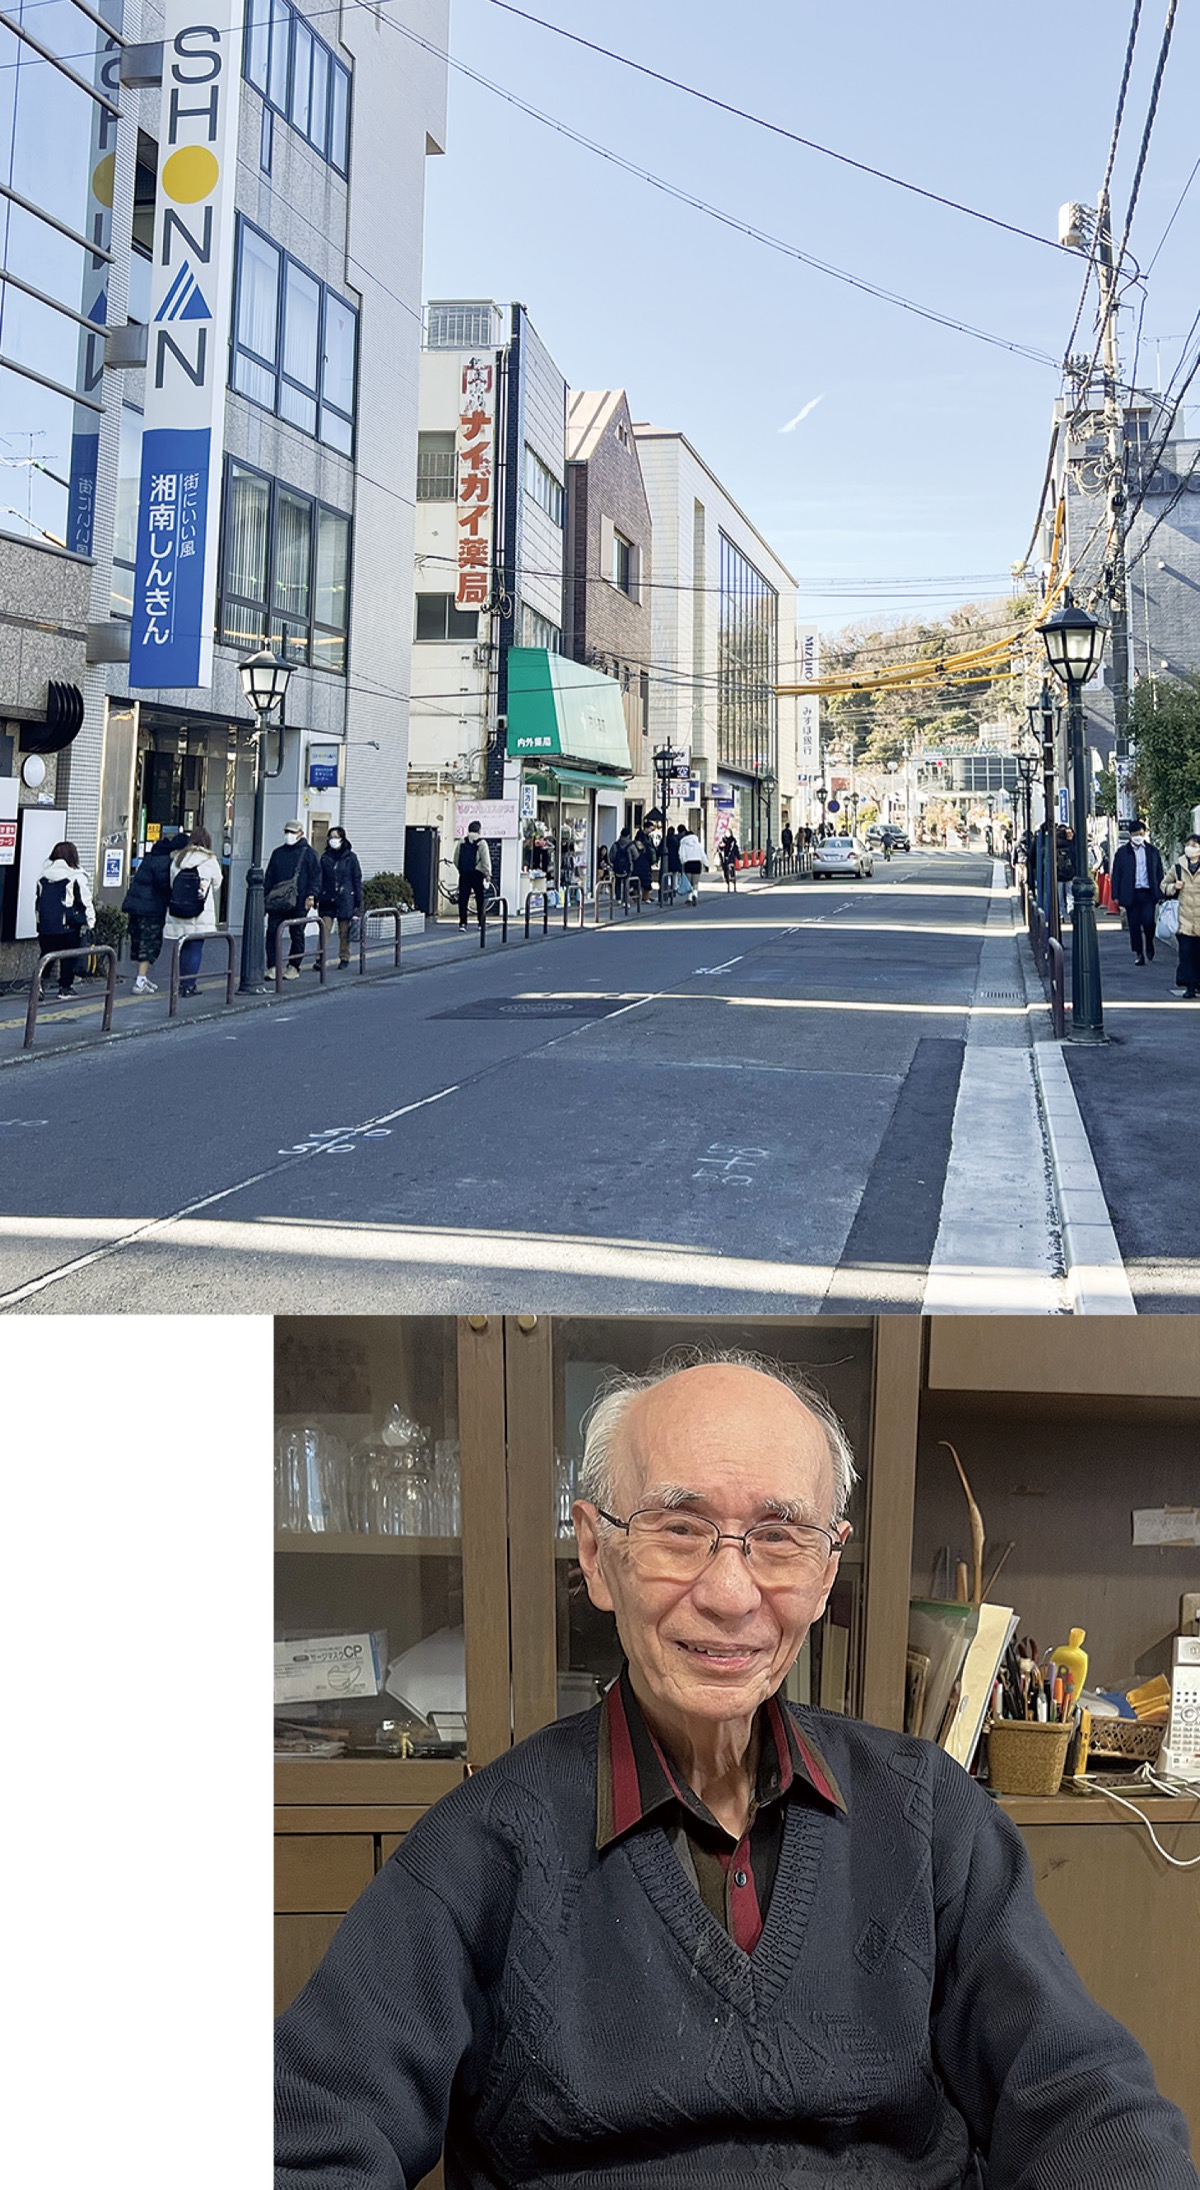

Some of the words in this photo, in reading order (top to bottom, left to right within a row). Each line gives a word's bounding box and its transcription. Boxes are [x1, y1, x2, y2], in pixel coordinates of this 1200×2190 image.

[179, 473, 199, 558] 街にいい風
[458, 409, 491, 604] ナイガイ薬局
[142, 474, 177, 645] 湘南しんきん
[804, 635, 814, 680] MIZUHO
[517, 736, 551, 748] 内外薬局
